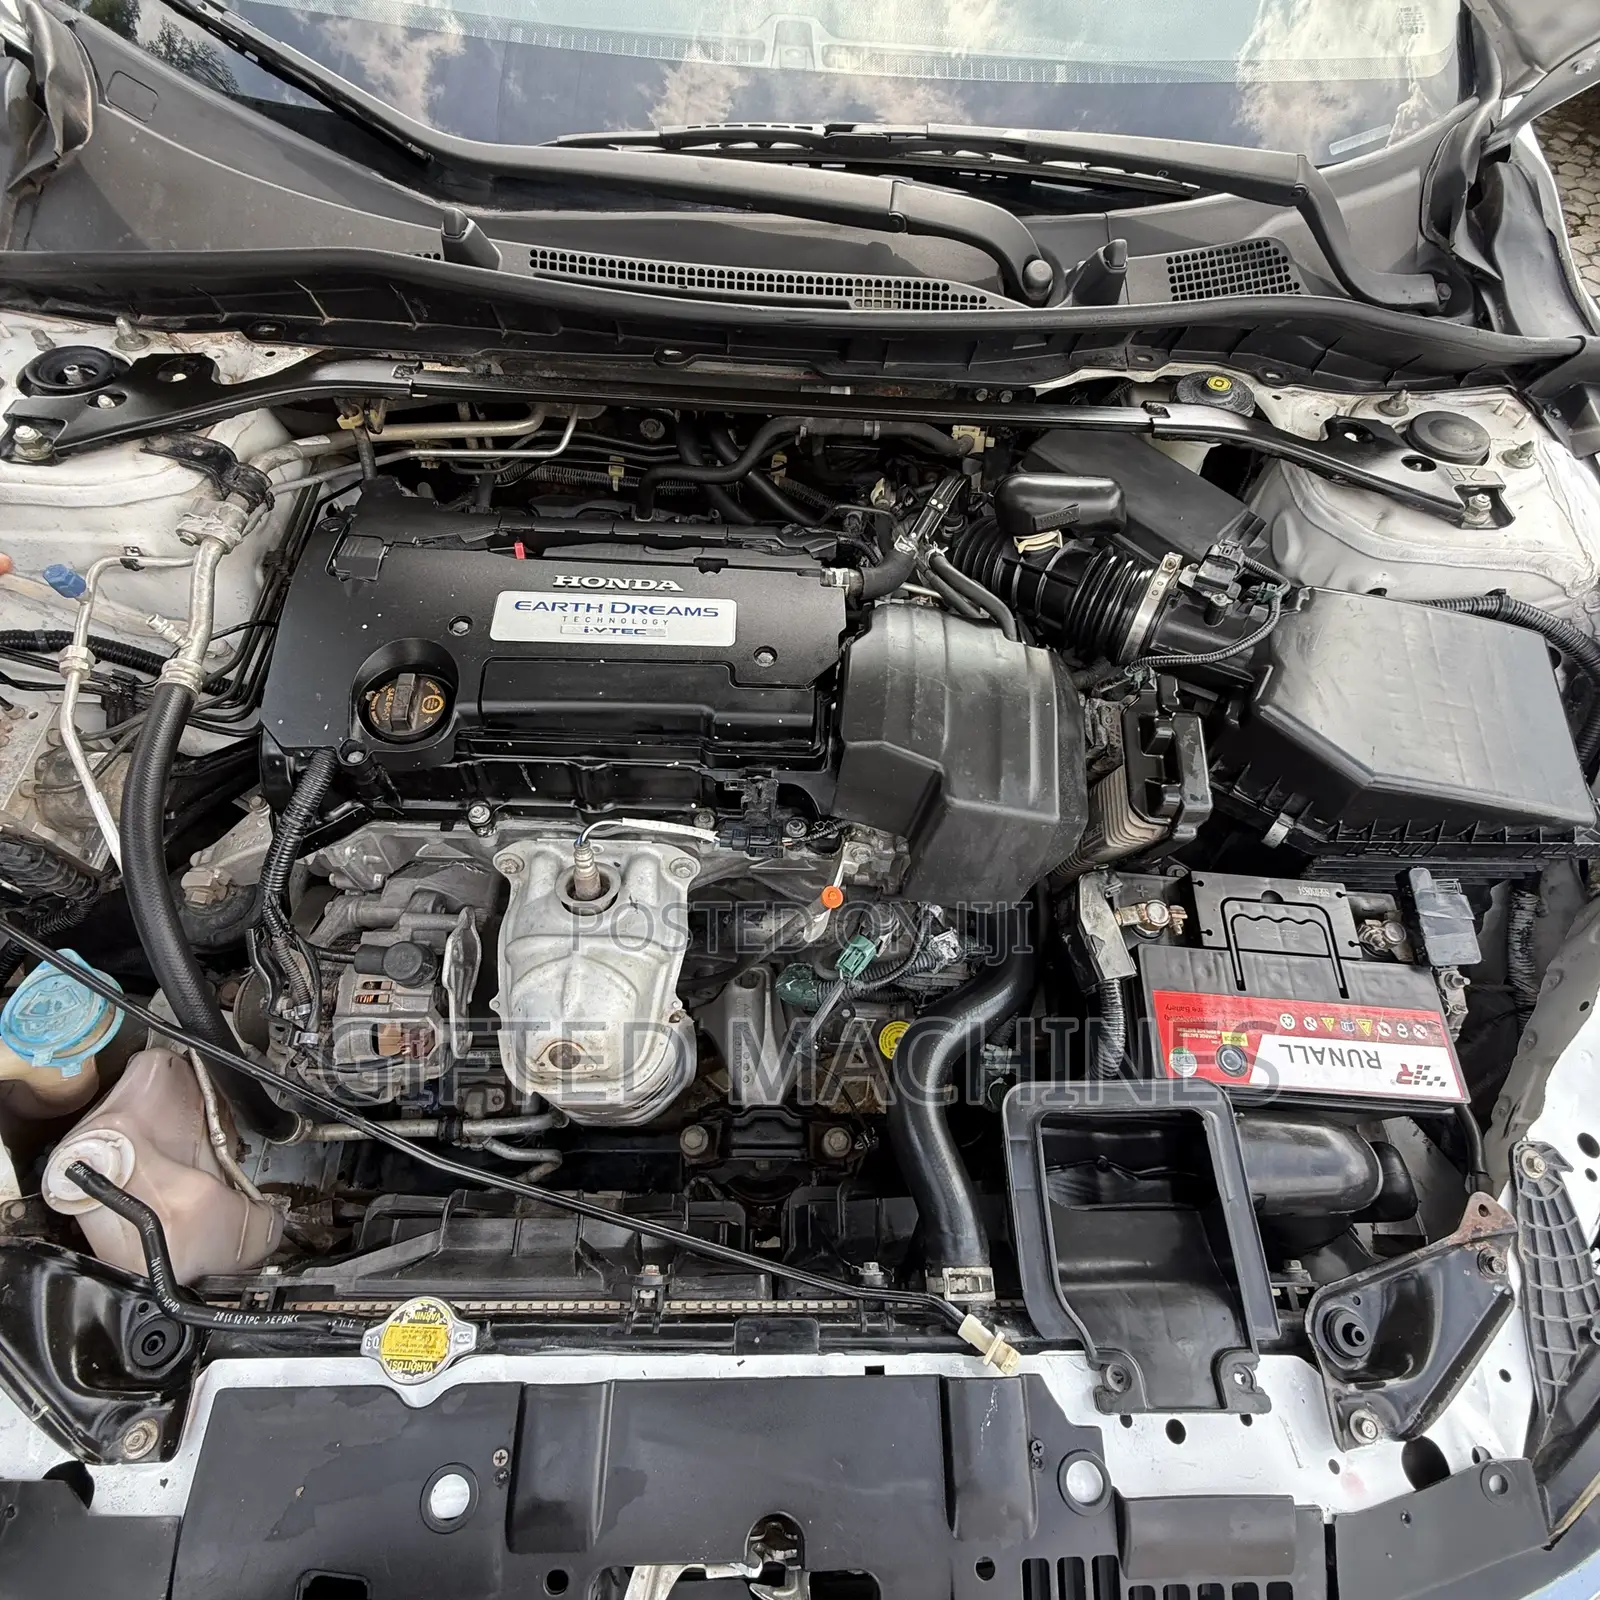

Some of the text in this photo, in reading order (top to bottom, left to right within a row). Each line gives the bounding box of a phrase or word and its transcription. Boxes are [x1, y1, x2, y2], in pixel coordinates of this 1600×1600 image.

[552, 574, 683, 592] HONDA
[514, 600, 720, 618] EARTH DREAMS
[563, 615, 669, 626] TECHNOLOGY
[1278, 1043, 1383, 1070] RUNALL
